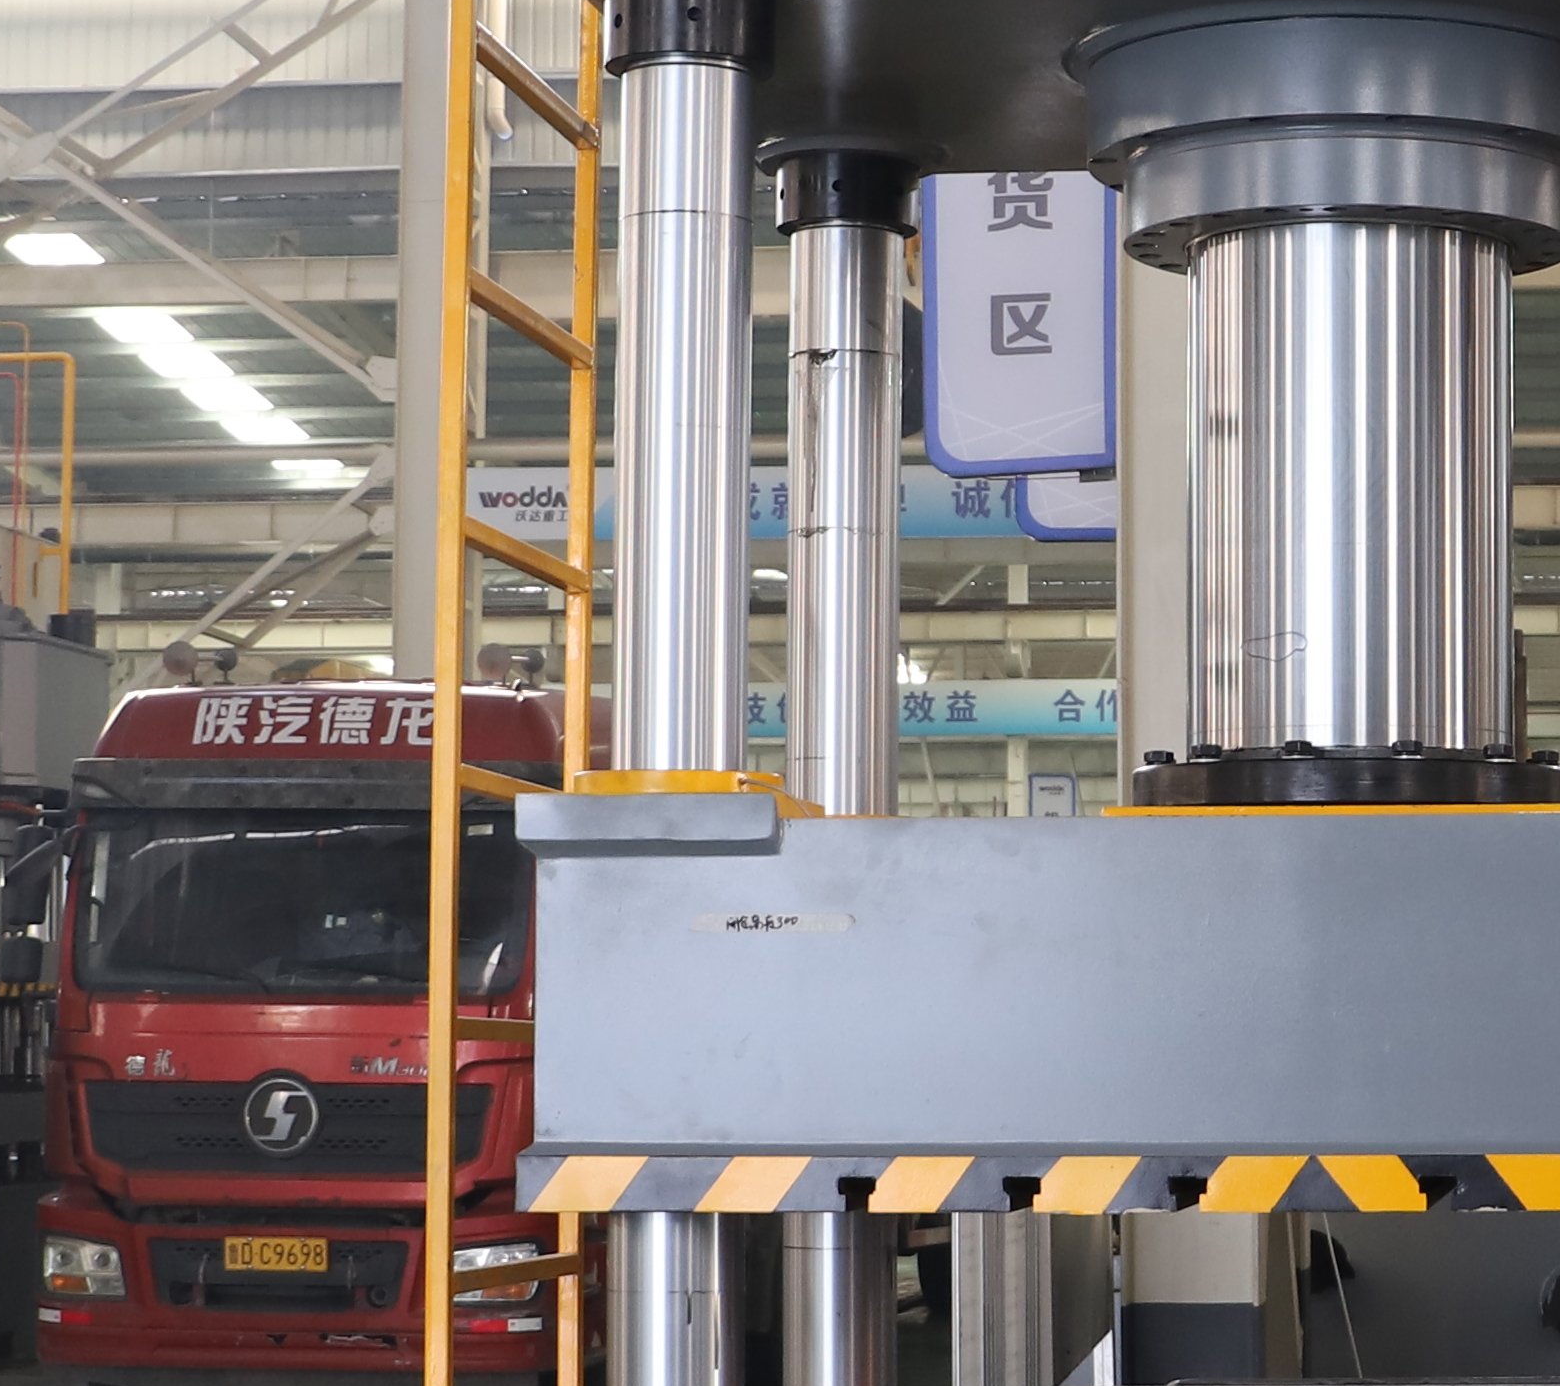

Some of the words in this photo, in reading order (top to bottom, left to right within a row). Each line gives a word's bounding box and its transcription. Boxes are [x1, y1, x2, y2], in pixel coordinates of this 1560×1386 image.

[192, 694, 434, 747] 陕汽德龙
[902, 690, 978, 724] 效益
